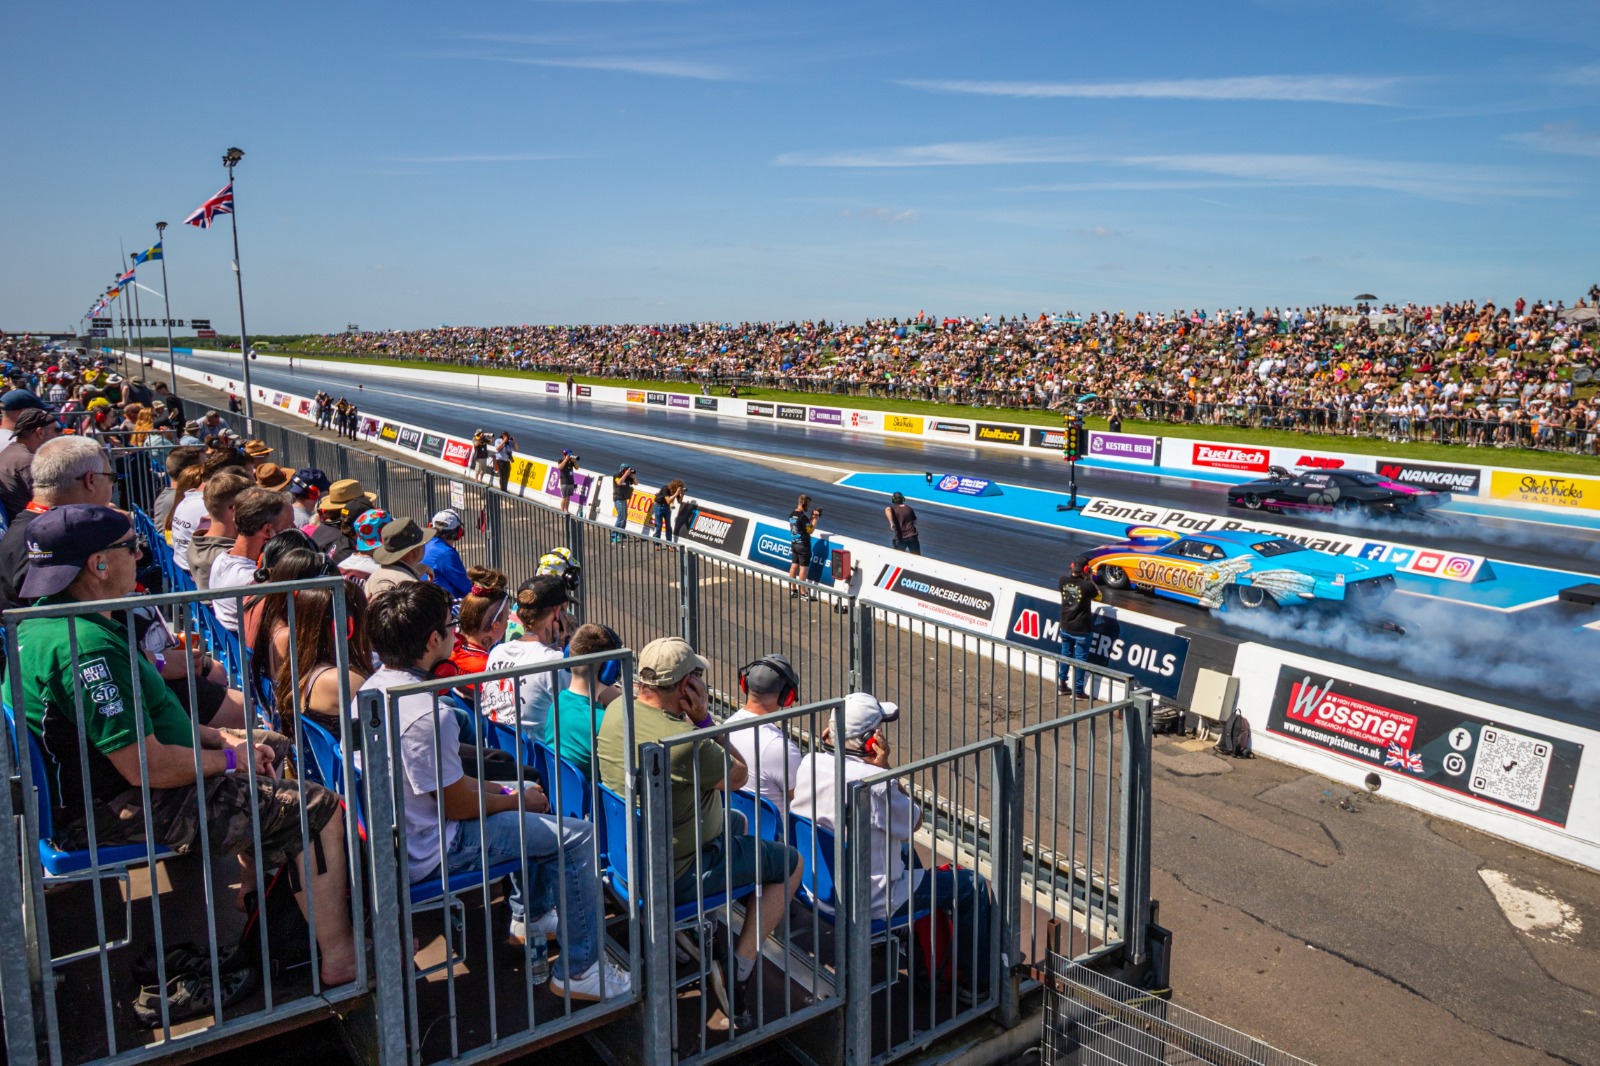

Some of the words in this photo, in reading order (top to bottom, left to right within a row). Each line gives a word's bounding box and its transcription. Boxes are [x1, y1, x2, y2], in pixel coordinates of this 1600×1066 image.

[120, 318, 157, 327] SANTA
[162, 318, 184, 327] POD
[979, 427, 1020, 441] Haltech
[1105, 441, 1133, 452] KESTREL
[1134, 444, 1152, 454] BEER
[1197, 446, 1265, 464] FuelTech
[1398, 469, 1477, 487] NANKANG
[1521, 494, 1578, 506] RACING
[1088, 500, 1158, 523] Santa
[1161, 511, 1217, 532] Pod
[917, 601, 989, 628] www.coatedracebearings.com
[83, 663, 104, 676] AUTO
[1127, 644, 1177, 677] OILS
[95, 685, 116, 701] STP
[1337, 698, 1350, 707] HIGH
[1350, 701, 1390, 718] PERFORMANCE
[1390, 713, 1414, 724] PISTONS
[1283, 721, 1381, 760] www.wossnerpistons.co.uk
[1314, 718, 1342, 731] RESEARCH
[1346, 727, 1385, 745] DEVELOPMENT
